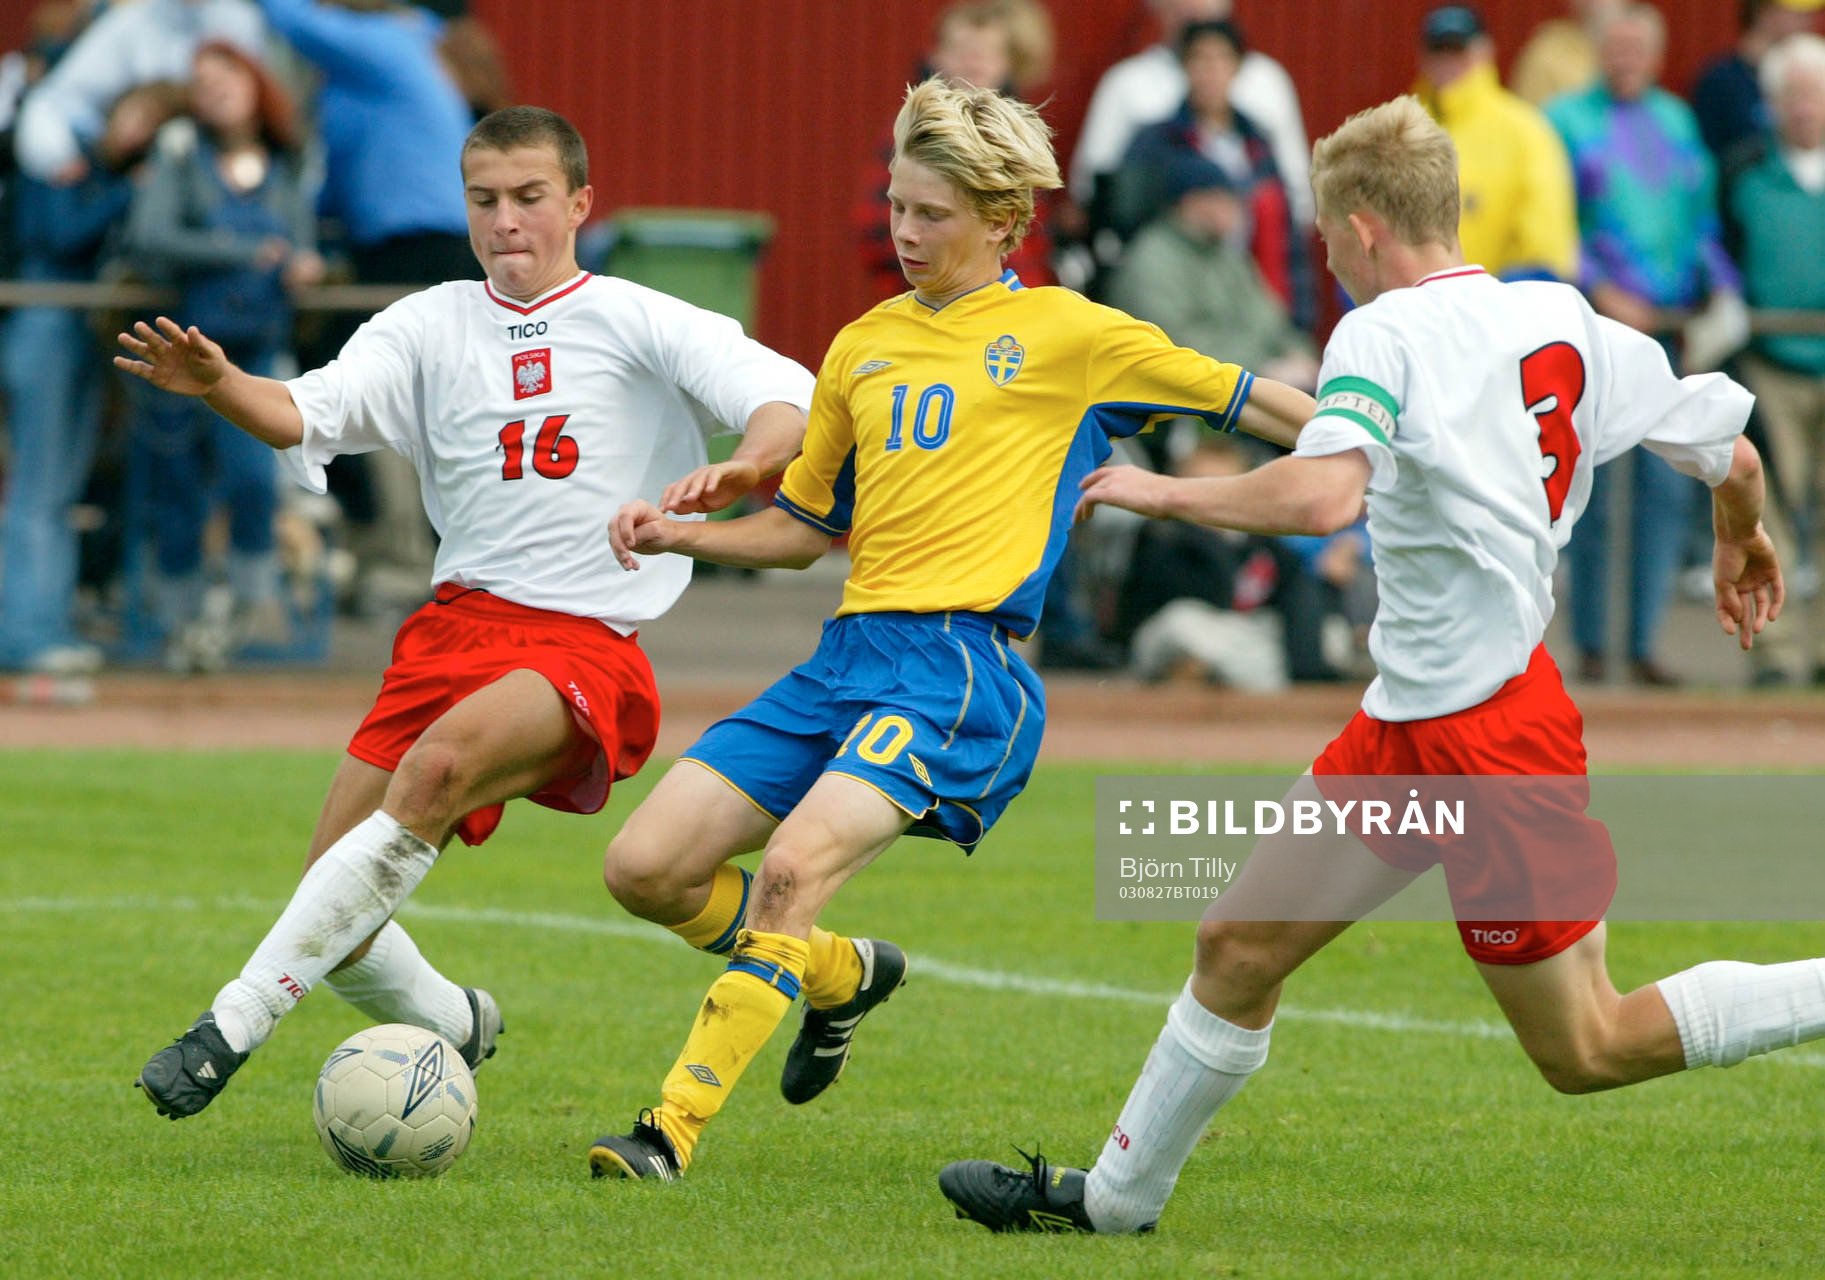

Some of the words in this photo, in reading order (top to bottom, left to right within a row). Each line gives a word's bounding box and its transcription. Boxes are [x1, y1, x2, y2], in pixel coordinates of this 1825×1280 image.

[507, 321, 548, 340] TICO
[885, 383, 955, 451] 10
[1322, 394, 1391, 431] APTEN
[496, 414, 579, 480] 16
[1520, 341, 1586, 527] 3
[1471, 928, 1518, 944] TICO
[1112, 1124, 1130, 1150] CO
